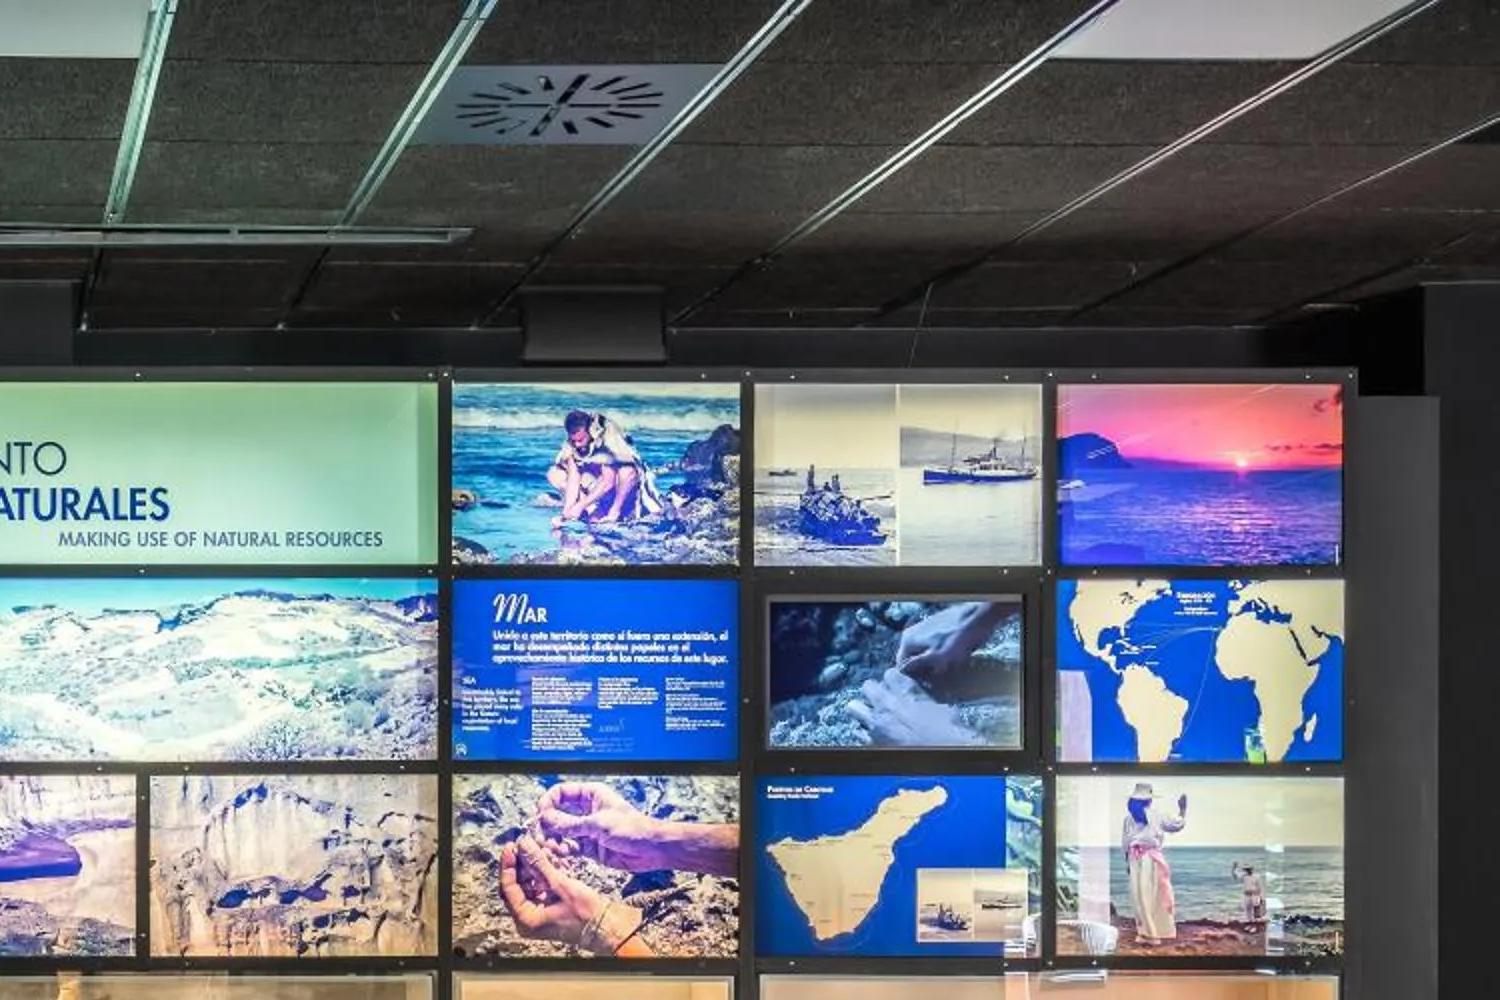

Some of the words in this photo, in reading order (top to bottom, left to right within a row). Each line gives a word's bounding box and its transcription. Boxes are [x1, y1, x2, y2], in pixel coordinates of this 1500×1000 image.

[58, 531, 133, 548] MAKING
[137, 531, 172, 548] USE
[175, 531, 198, 548] OF
[202, 531, 281, 548] NATURAL
[285, 531, 384, 548] RESOURCES
[493, 593, 548, 624] MAR
